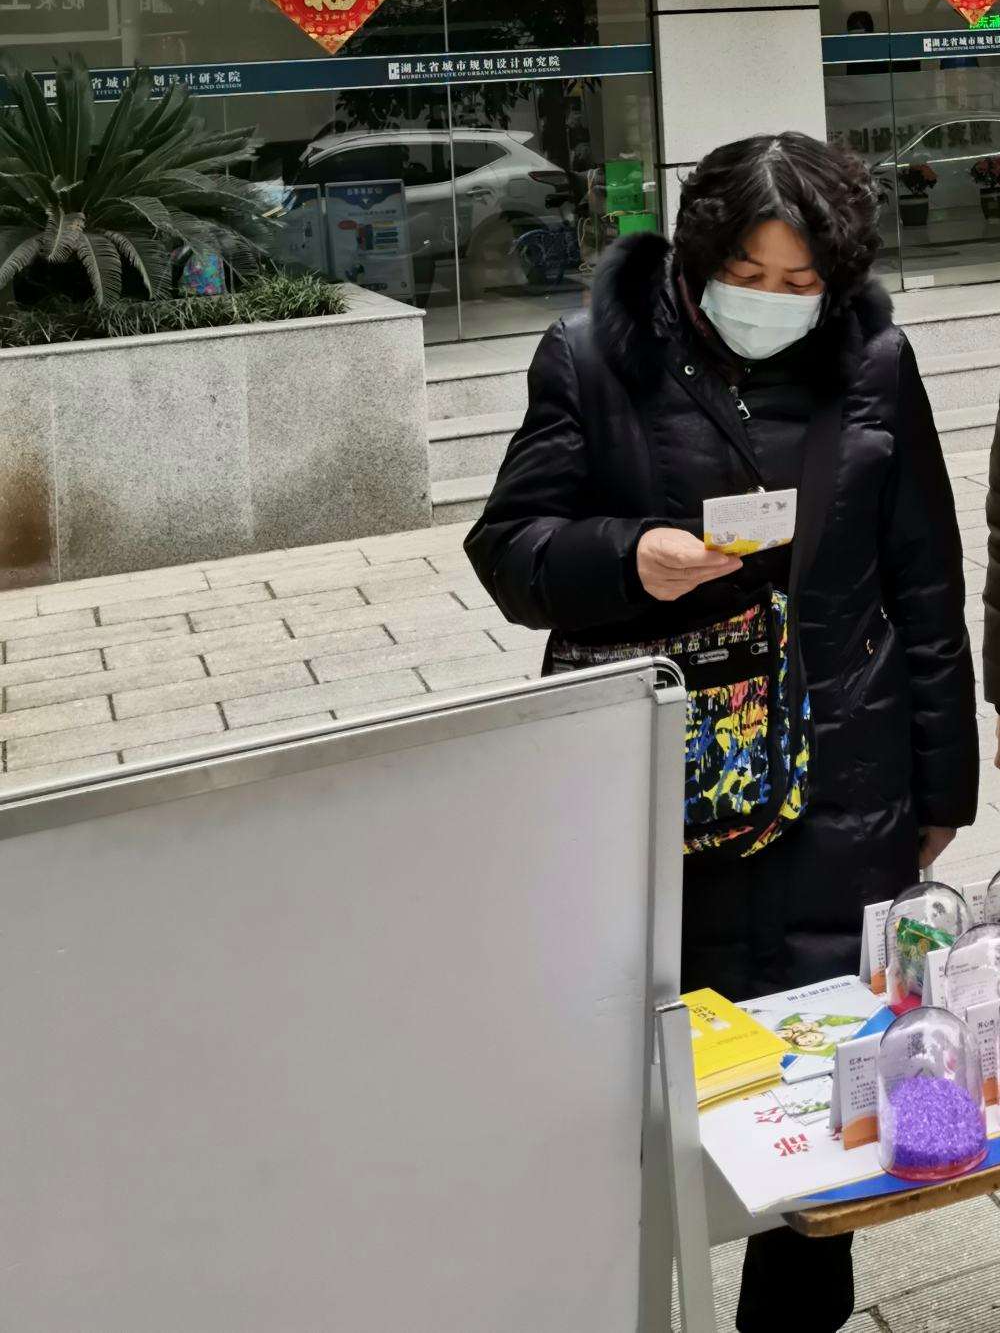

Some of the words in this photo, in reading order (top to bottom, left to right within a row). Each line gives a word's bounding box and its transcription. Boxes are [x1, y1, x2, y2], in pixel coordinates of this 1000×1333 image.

[401, 55, 560, 73] 湖北省城市规划设计研究院
